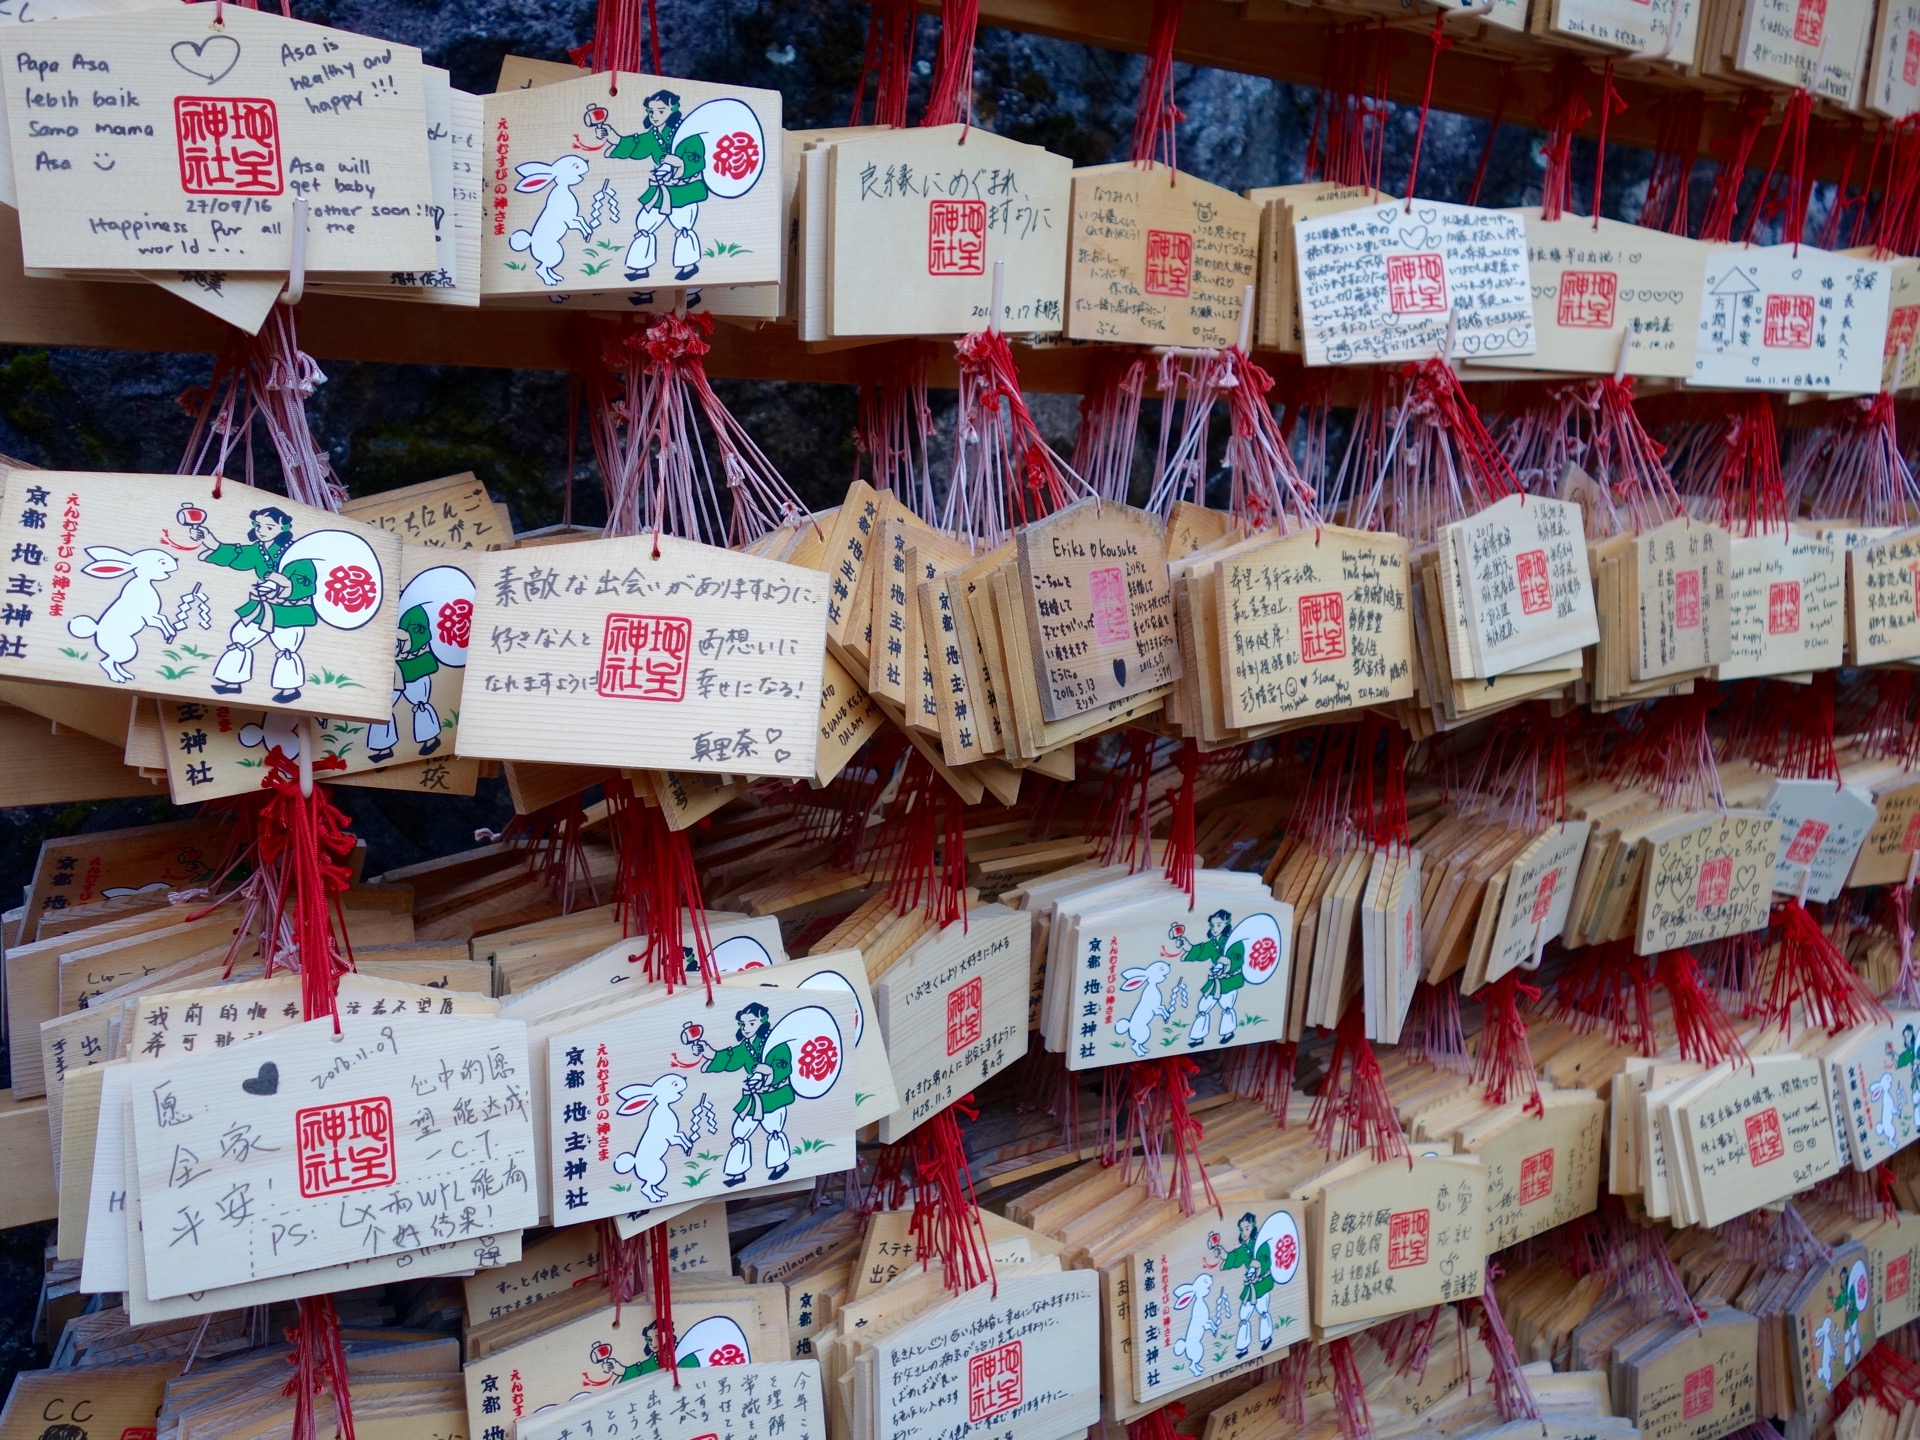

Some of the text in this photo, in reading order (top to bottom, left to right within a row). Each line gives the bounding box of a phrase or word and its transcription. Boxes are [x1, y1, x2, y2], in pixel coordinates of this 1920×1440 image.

[16, 51, 111, 83] Papa Asa
[280, 36, 339, 67] Asa is
[289, 48, 392, 91] healthy and
[35, 150, 72, 172] Asa
[289, 156, 371, 175] Asa will
[493, 116, 510, 237] えんむすびの神さま
[712, 131, 760, 181] 縁
[334, 176, 376, 201] baby
[371, 204, 411, 217] soon
[48, 491, 81, 618] えんむすびの神さま
[1052, 537, 1086, 558] Erika
[0, 485, 52, 659] 京都地主神社
[323, 564, 377, 613] 縁
[490, 625, 593, 655] 好きな人と
[1248, 936, 1279, 973] 縁
[1079, 937, 1103, 1060] 京都地主神社
[1103, 935, 1119, 1026] えんむすびの神さま
[797, 1035, 839, 1082] 縁
[596, 1043, 610, 1162] えんむすびの神さま
[563, 1045, 590, 1211] 京都地主神社
[1143, 1257, 1162, 1389] 京都地主神社
[1160, 1254, 1172, 1348] えんむすびの神さま
